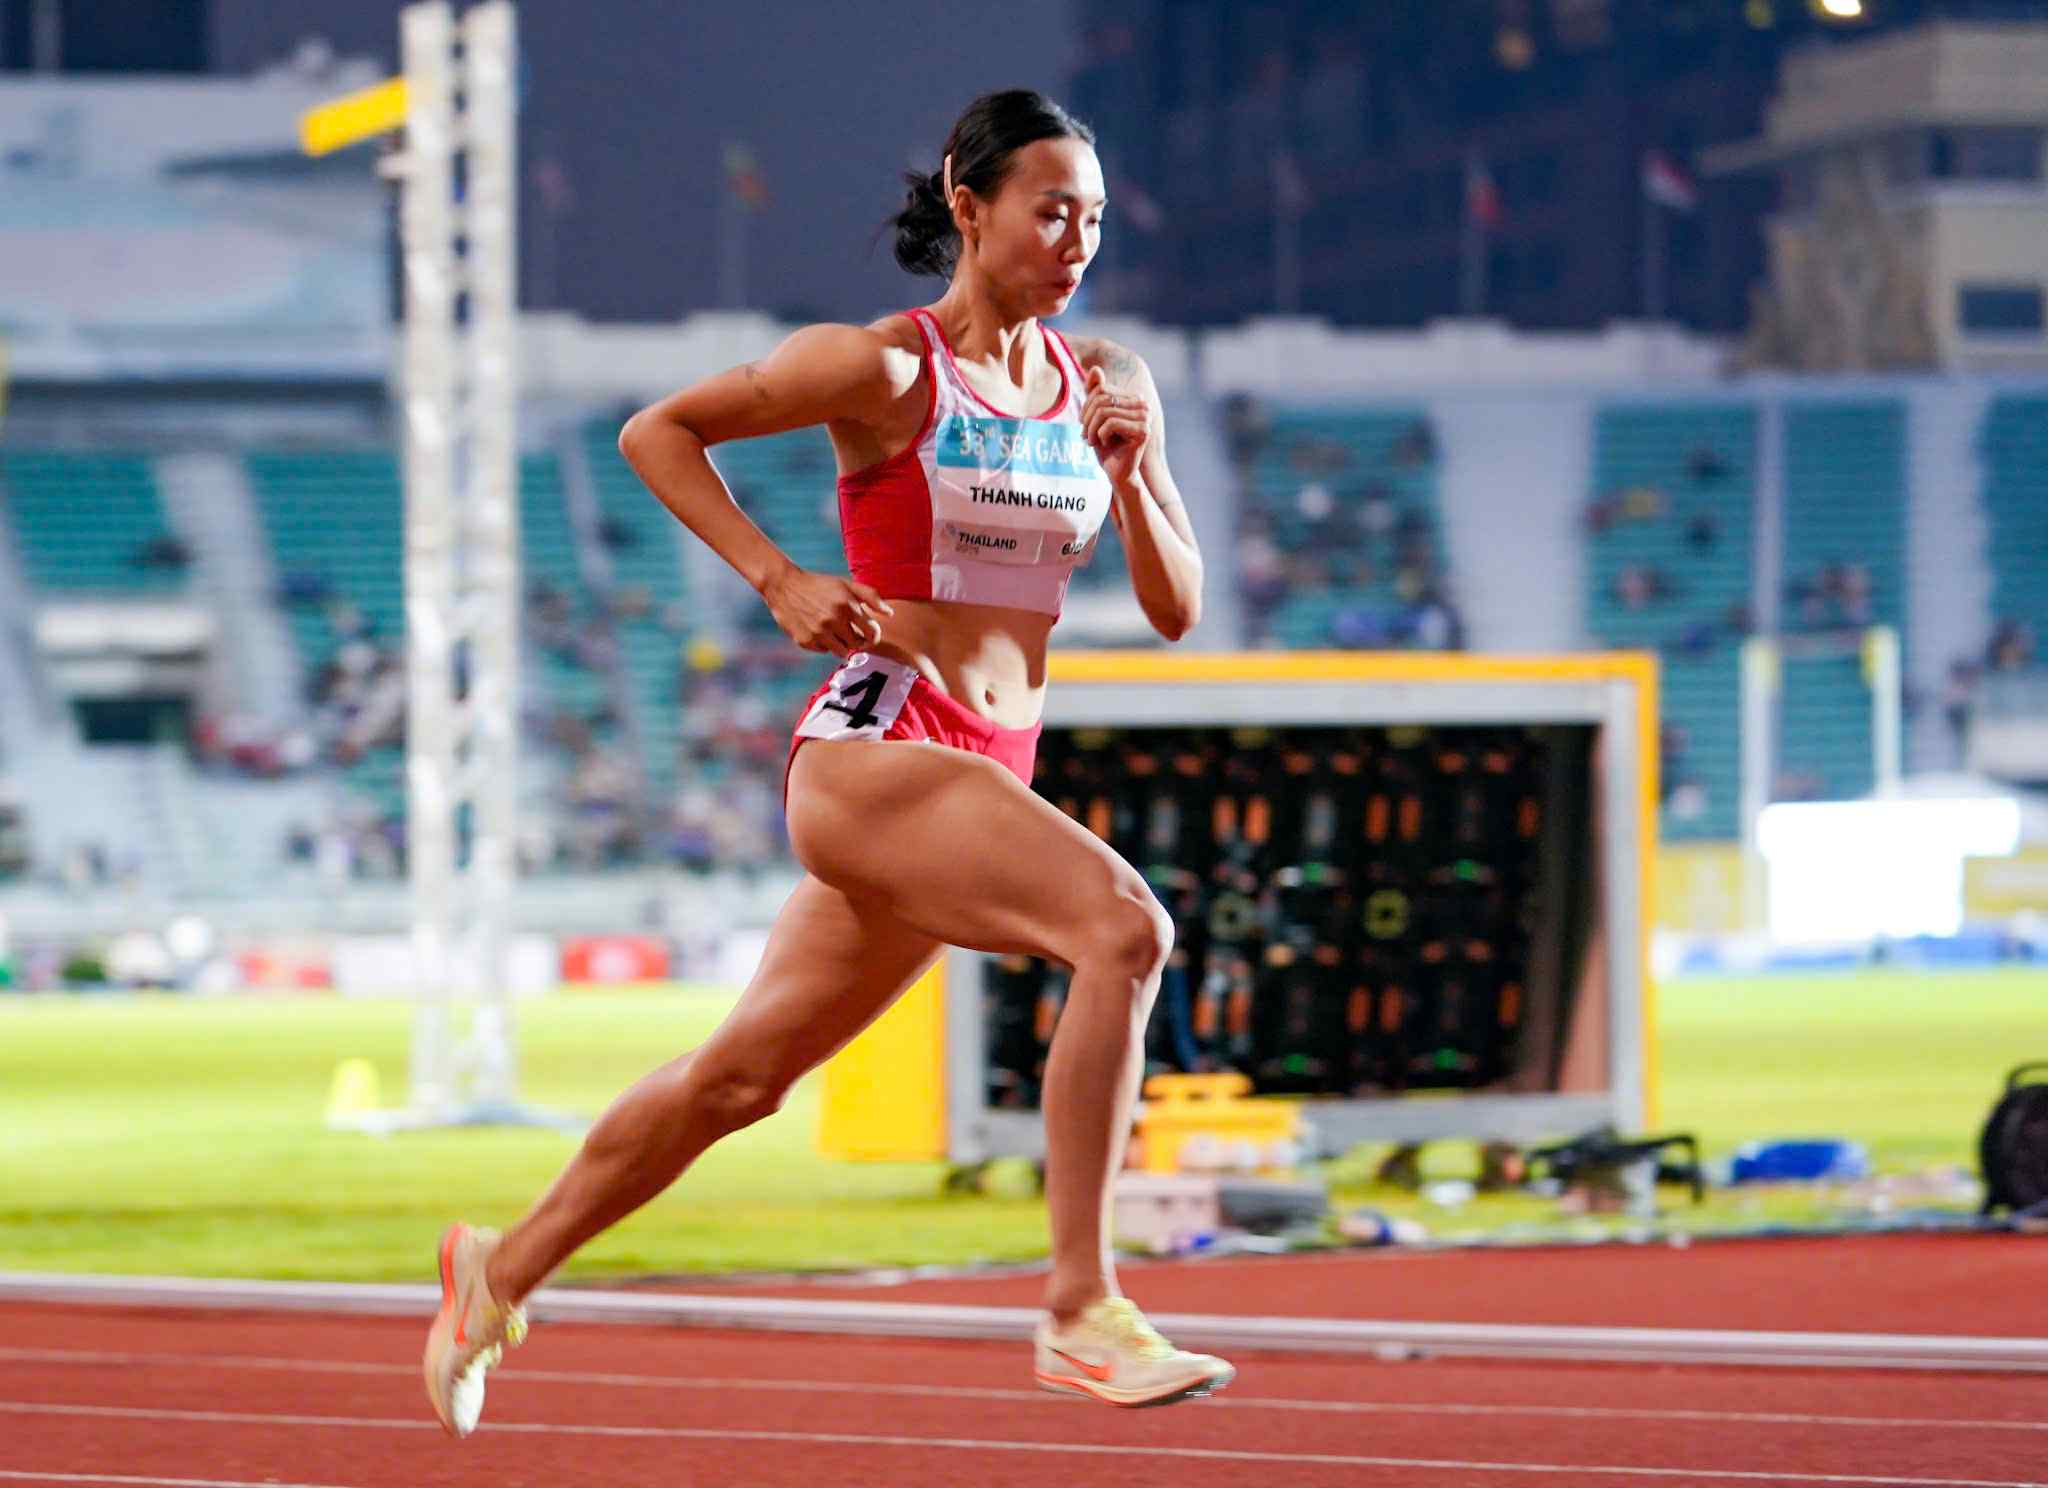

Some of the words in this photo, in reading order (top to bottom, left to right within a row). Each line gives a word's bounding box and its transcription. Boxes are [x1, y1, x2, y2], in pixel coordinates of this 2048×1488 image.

[1034, 437, 1093, 466] GAME
[969, 486, 1033, 508] THANH
[1036, 493, 1087, 512] GIANG
[959, 532, 1018, 550] THAILAND
[822, 671, 889, 730] 4
